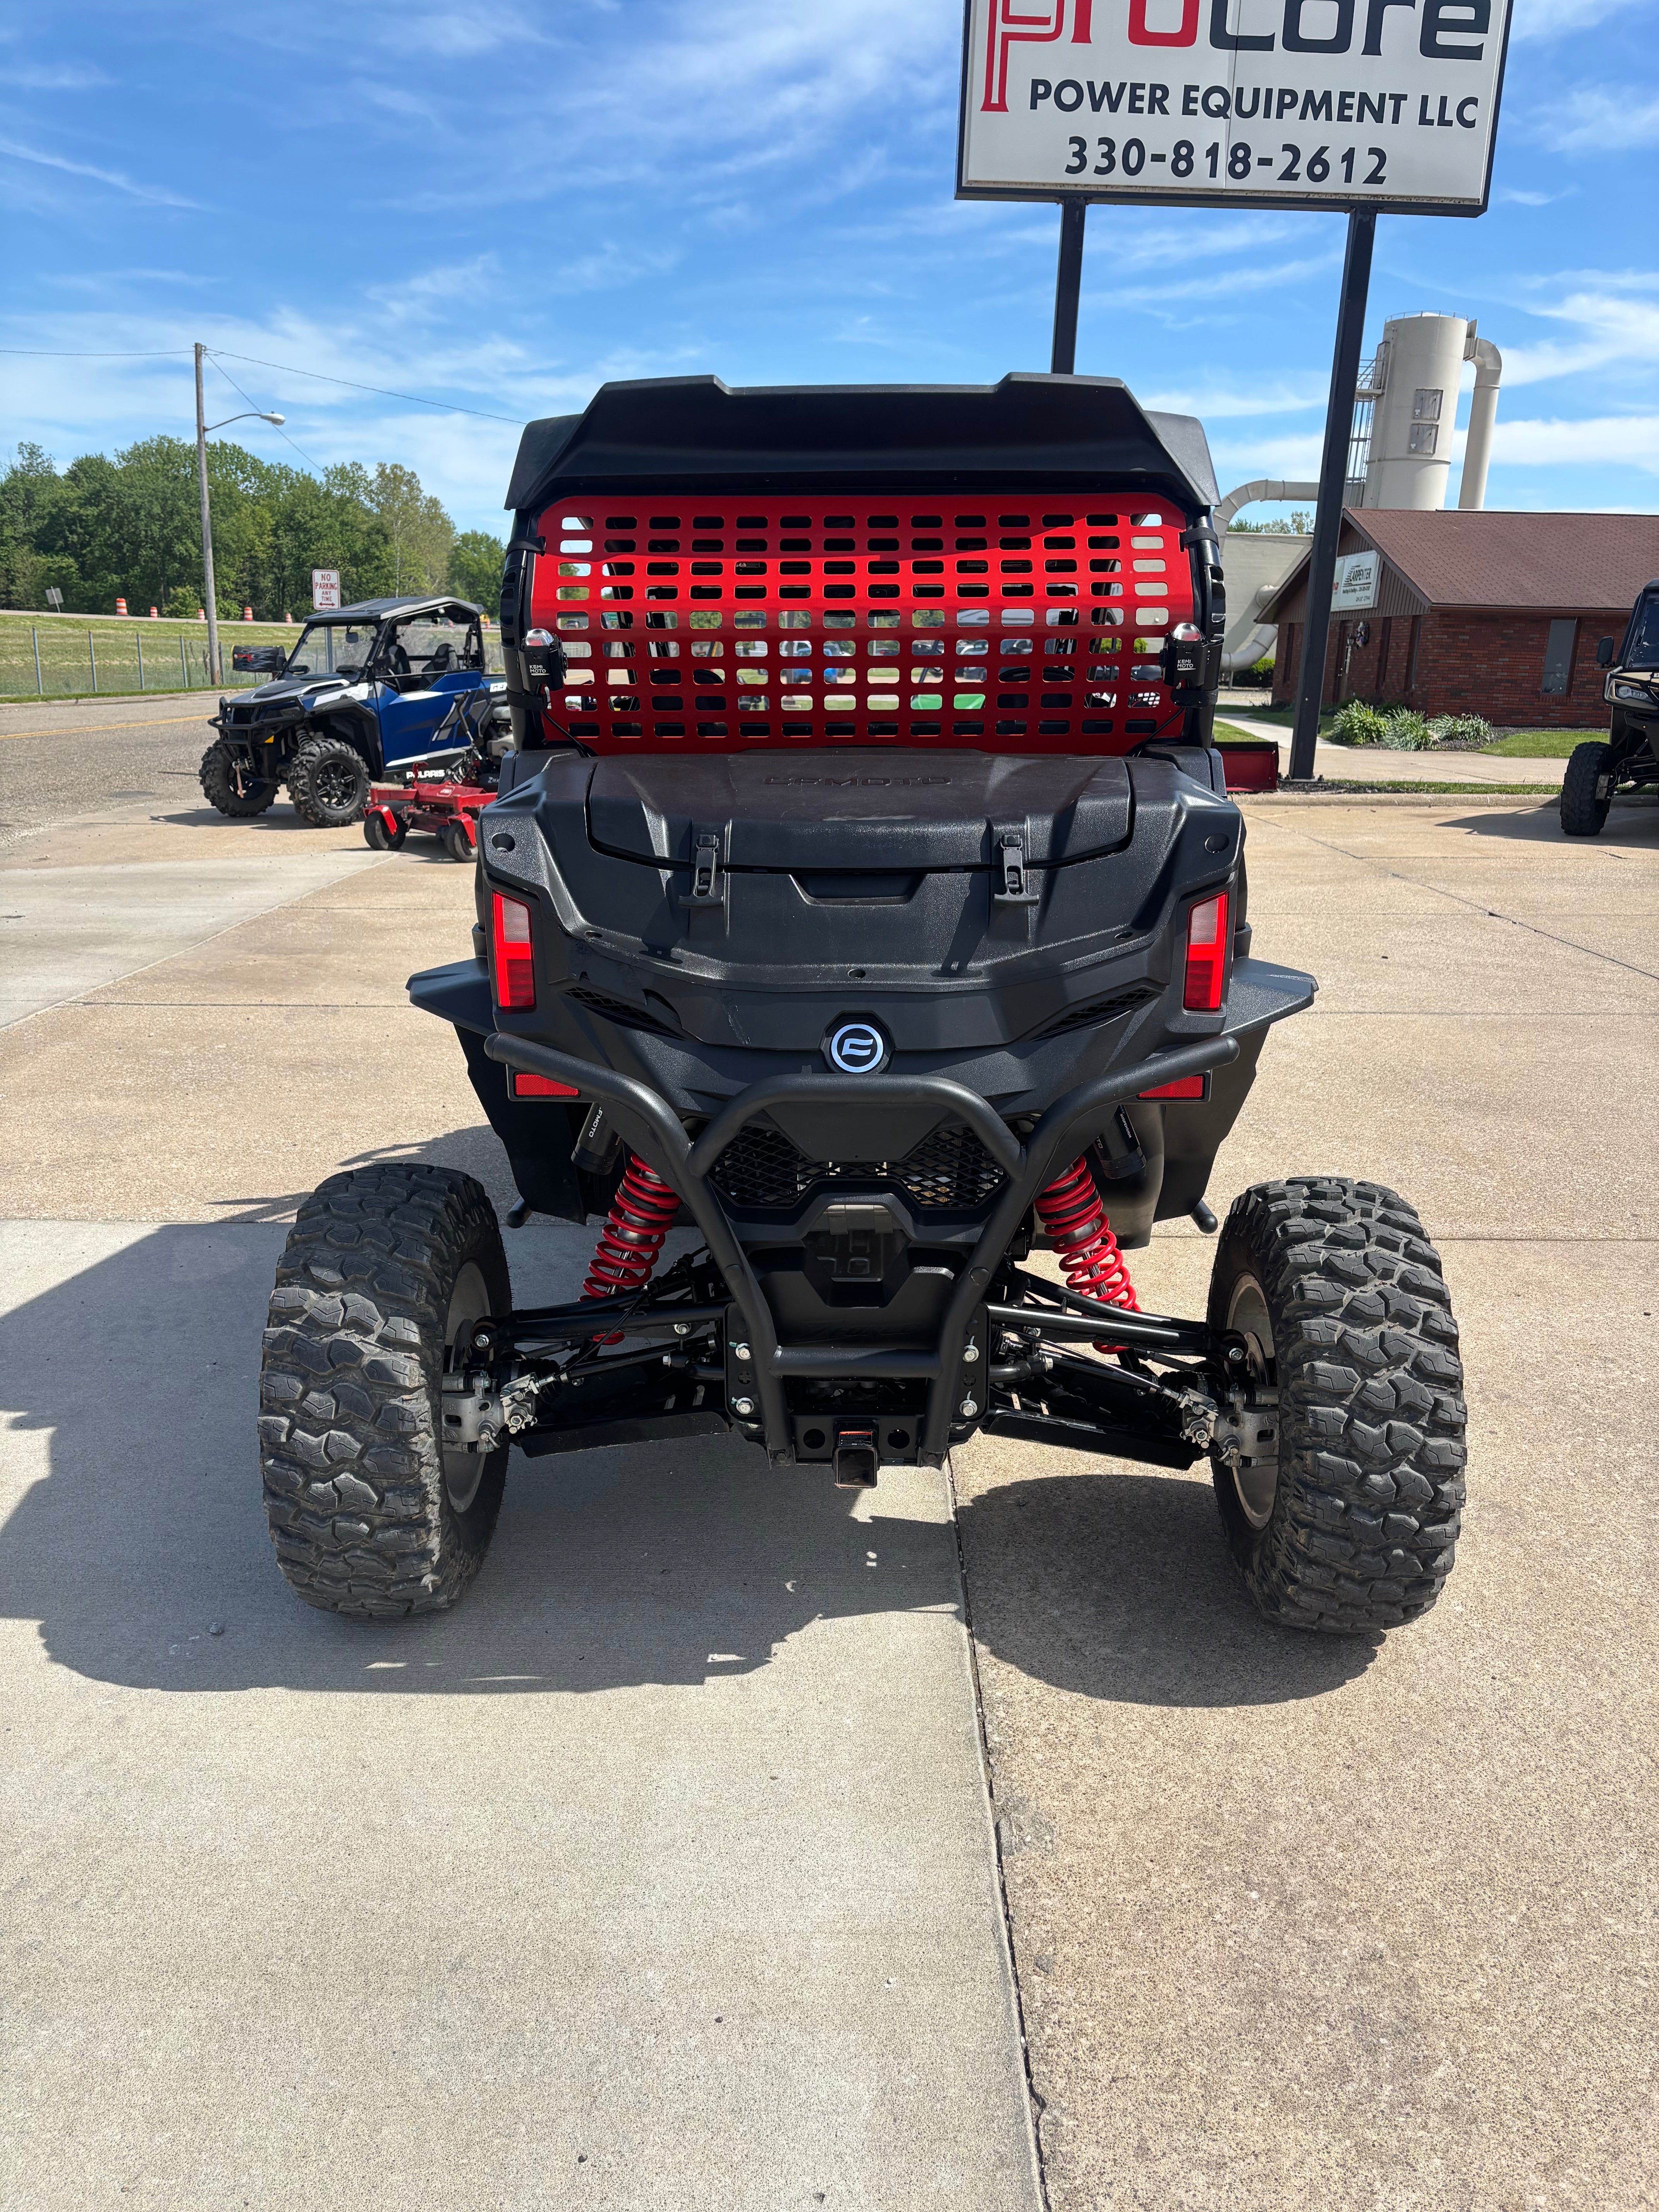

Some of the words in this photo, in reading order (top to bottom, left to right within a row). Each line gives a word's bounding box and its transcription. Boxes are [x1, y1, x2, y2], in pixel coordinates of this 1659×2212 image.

[1029, 78, 1170, 115] POWER
[1182, 84, 1408, 125] EQUIPMENT
[1418, 94, 1479, 129] LLC
[1064, 136, 1388, 185] 330-818-2612
[321, 573, 331, 581] NO
[406, 769, 445, 779] PLARIS
[589, 1107, 603, 1137] FMOTO
